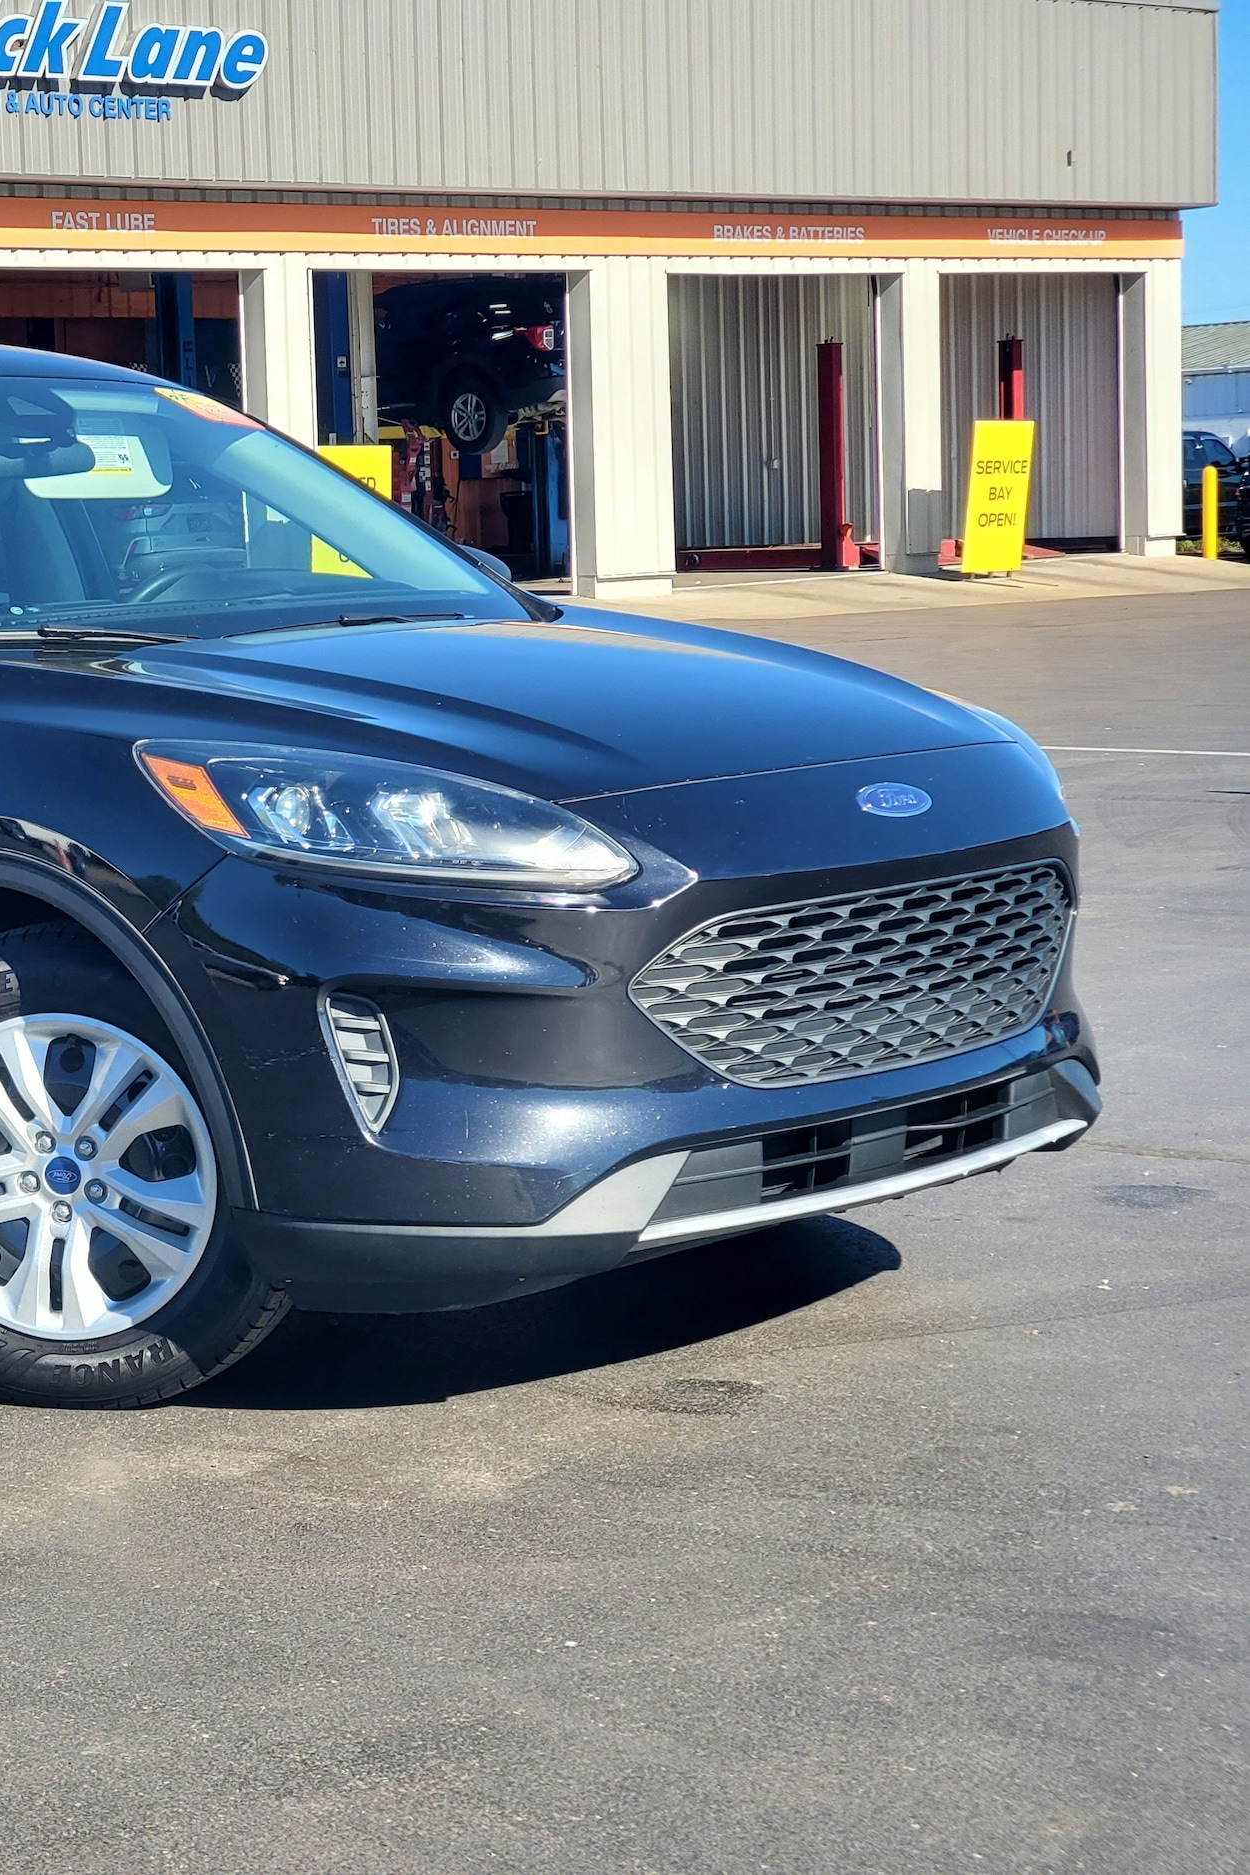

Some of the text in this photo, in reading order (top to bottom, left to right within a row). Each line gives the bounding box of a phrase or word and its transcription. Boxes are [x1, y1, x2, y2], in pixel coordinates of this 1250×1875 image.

[78, 1, 269, 89] Lane
[5, 90, 19, 114] &
[25, 92, 84, 117] AUTO
[89, 96, 171, 120] CENTER
[52, 211, 155, 232] FAST LUBE
[371, 218, 537, 238] TIRES & ALIGNMENT
[713, 225, 865, 244] BRAKES & BATTERIES
[987, 229, 1106, 246] VEHICLE CHECK-UP
[976, 460, 1028, 475] SERVICE
[989, 487, 1013, 501] BAY
[978, 512, 1016, 527] OPEN!
[877, 788, 918, 808] Ford
